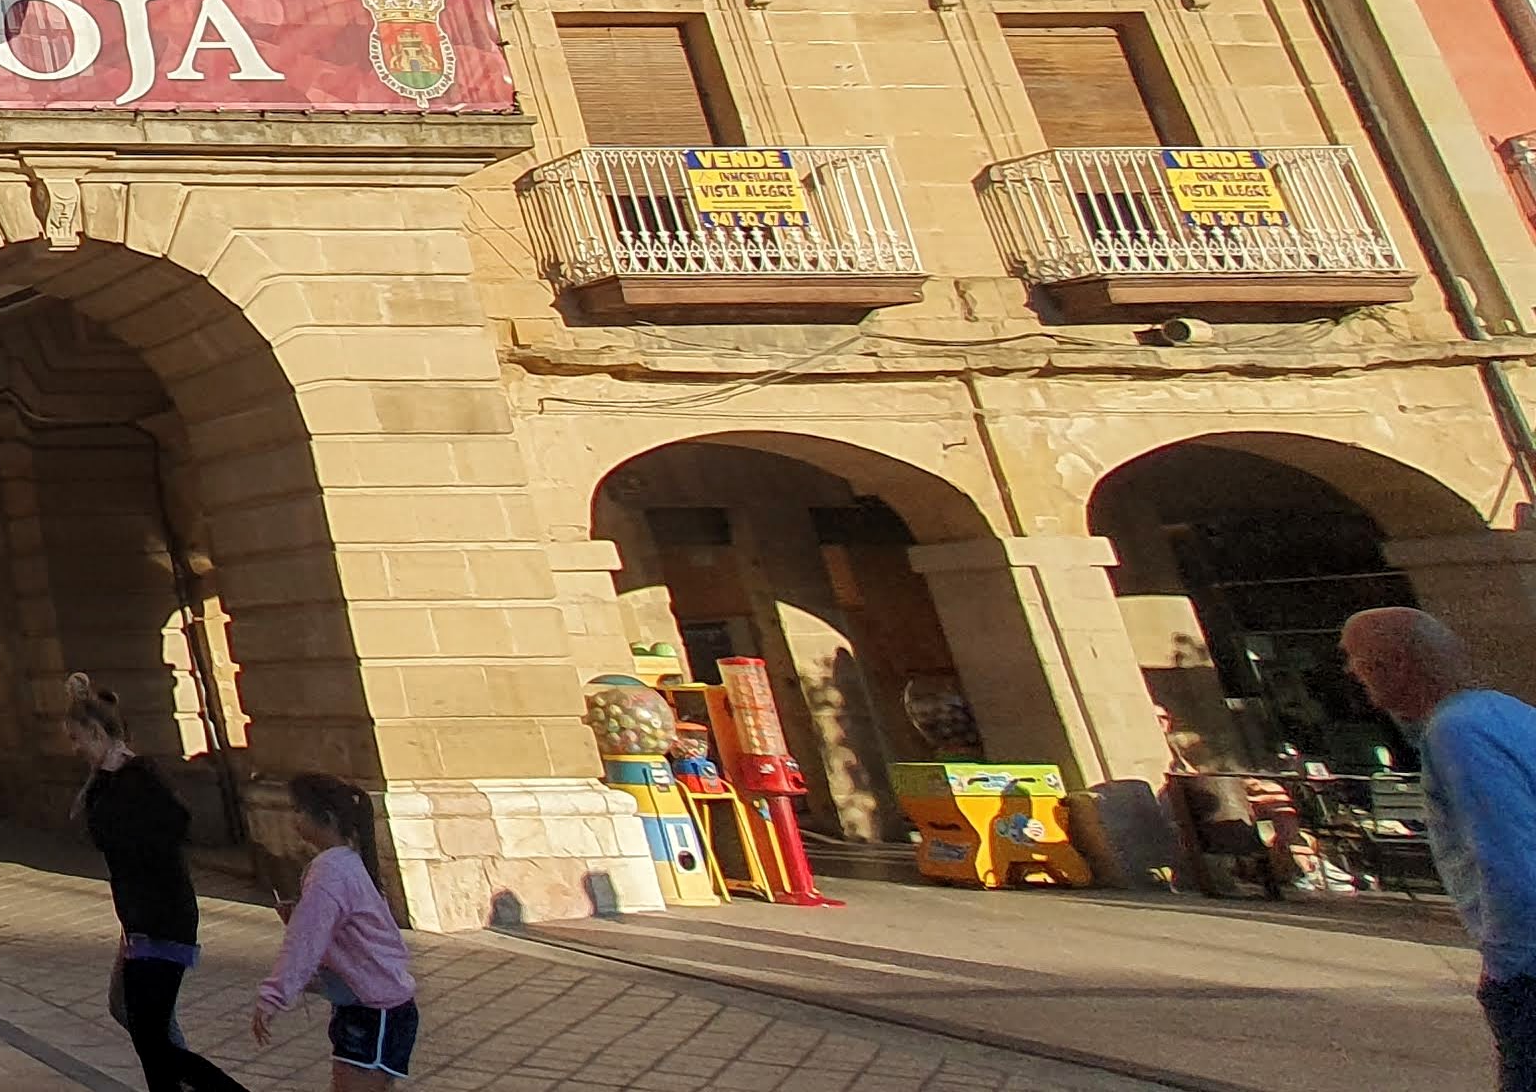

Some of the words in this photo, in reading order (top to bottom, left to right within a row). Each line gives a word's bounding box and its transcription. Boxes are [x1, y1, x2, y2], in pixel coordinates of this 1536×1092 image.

[694, 151, 785, 168] VENDE
[1169, 151, 1258, 168] VENDE
[699, 184, 740, 197] VISTA
[745, 184, 796, 197] ALEGRE
[1179, 184, 1218, 197] VISTA
[1223, 184, 1273, 197] ALEGRE
